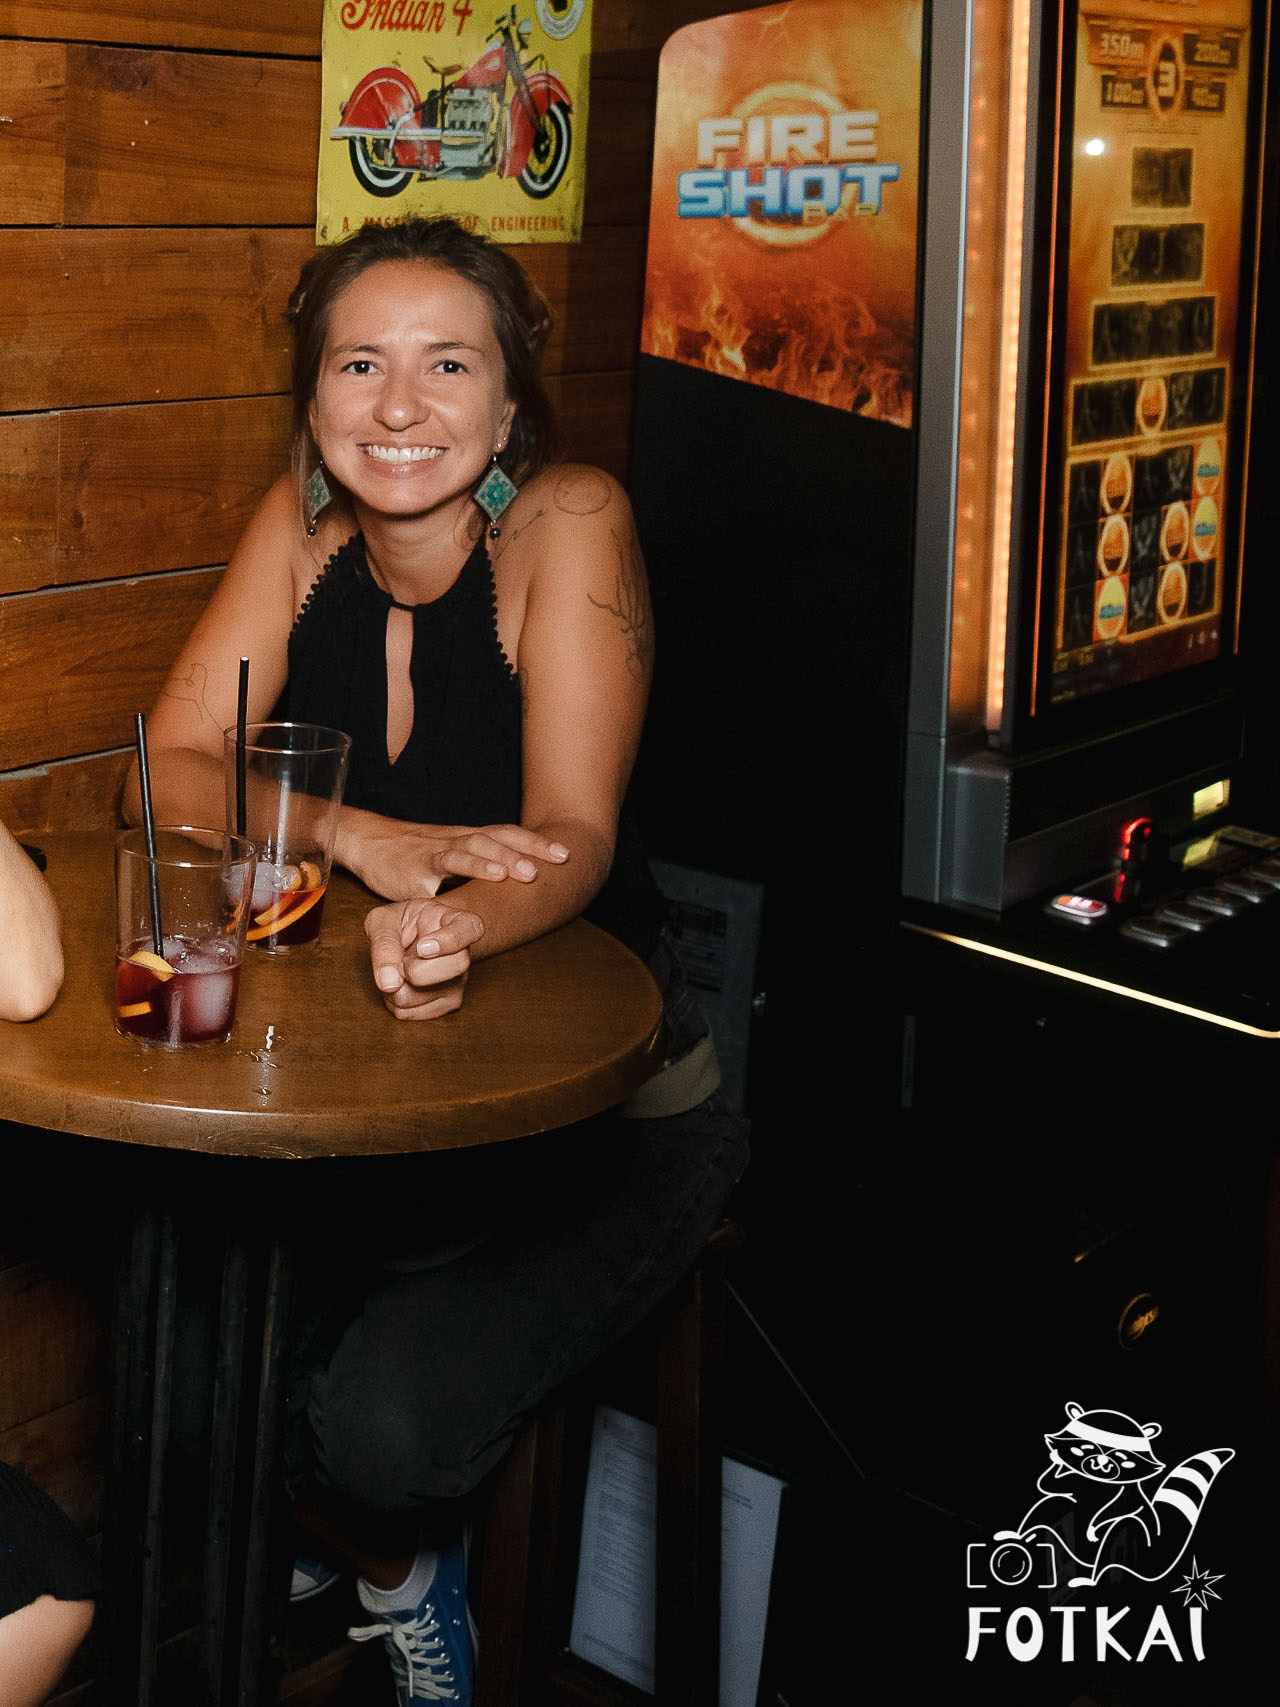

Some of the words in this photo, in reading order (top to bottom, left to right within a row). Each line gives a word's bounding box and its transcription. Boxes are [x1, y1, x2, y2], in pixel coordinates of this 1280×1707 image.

[340, 0, 445, 33] Indian
[453, 0, 472, 36] 4
[697, 111, 879, 168] FIRE
[677, 163, 901, 218] SHOT
[342, 216, 350, 232] A
[490, 214, 566, 233] ENGINEERING
